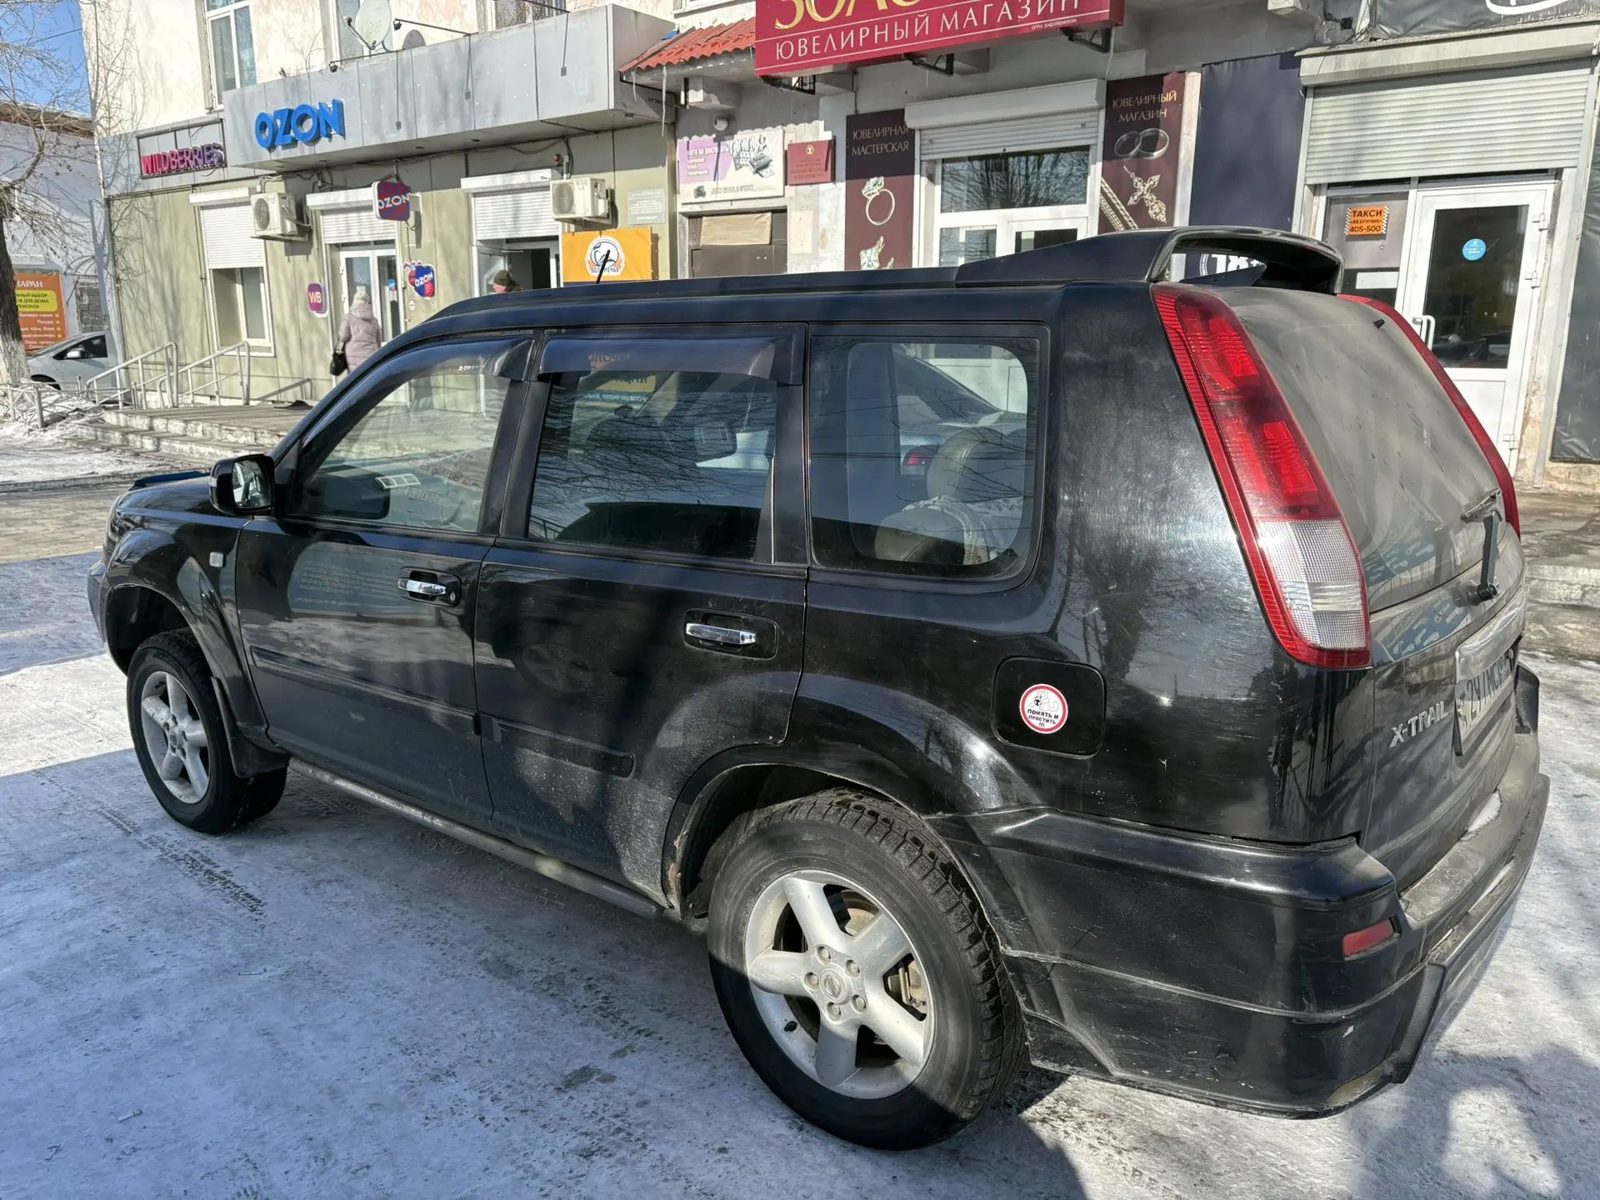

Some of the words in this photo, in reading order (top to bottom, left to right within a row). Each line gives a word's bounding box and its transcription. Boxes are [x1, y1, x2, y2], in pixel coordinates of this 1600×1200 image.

[776, 13, 929, 60] ЮВЕЛИРНЫЙ
[1112, 90, 1177, 108] ЮВЕЛИРНЫЙ
[1119, 108, 1167, 122] МАГАЗИН
[255, 99, 345, 150] OZON
[852, 125, 909, 140] ЮВЕЛИРНАЯ
[851, 141, 910, 156] МАСТЕРСКАЯ
[141, 143, 225, 177] WILDBERRIES
[378, 192, 411, 209] OZON
[1352, 209, 1383, 218] ТАКСИ
[414, 271, 434, 287] OZON
[308, 291, 322, 303] WB
[1027, 708, 1053, 719] ПОНЯТЬ
[1028, 715, 1057, 725] ПРОСТИТЬ
[1388, 701, 1449, 749] X-TRAIL
